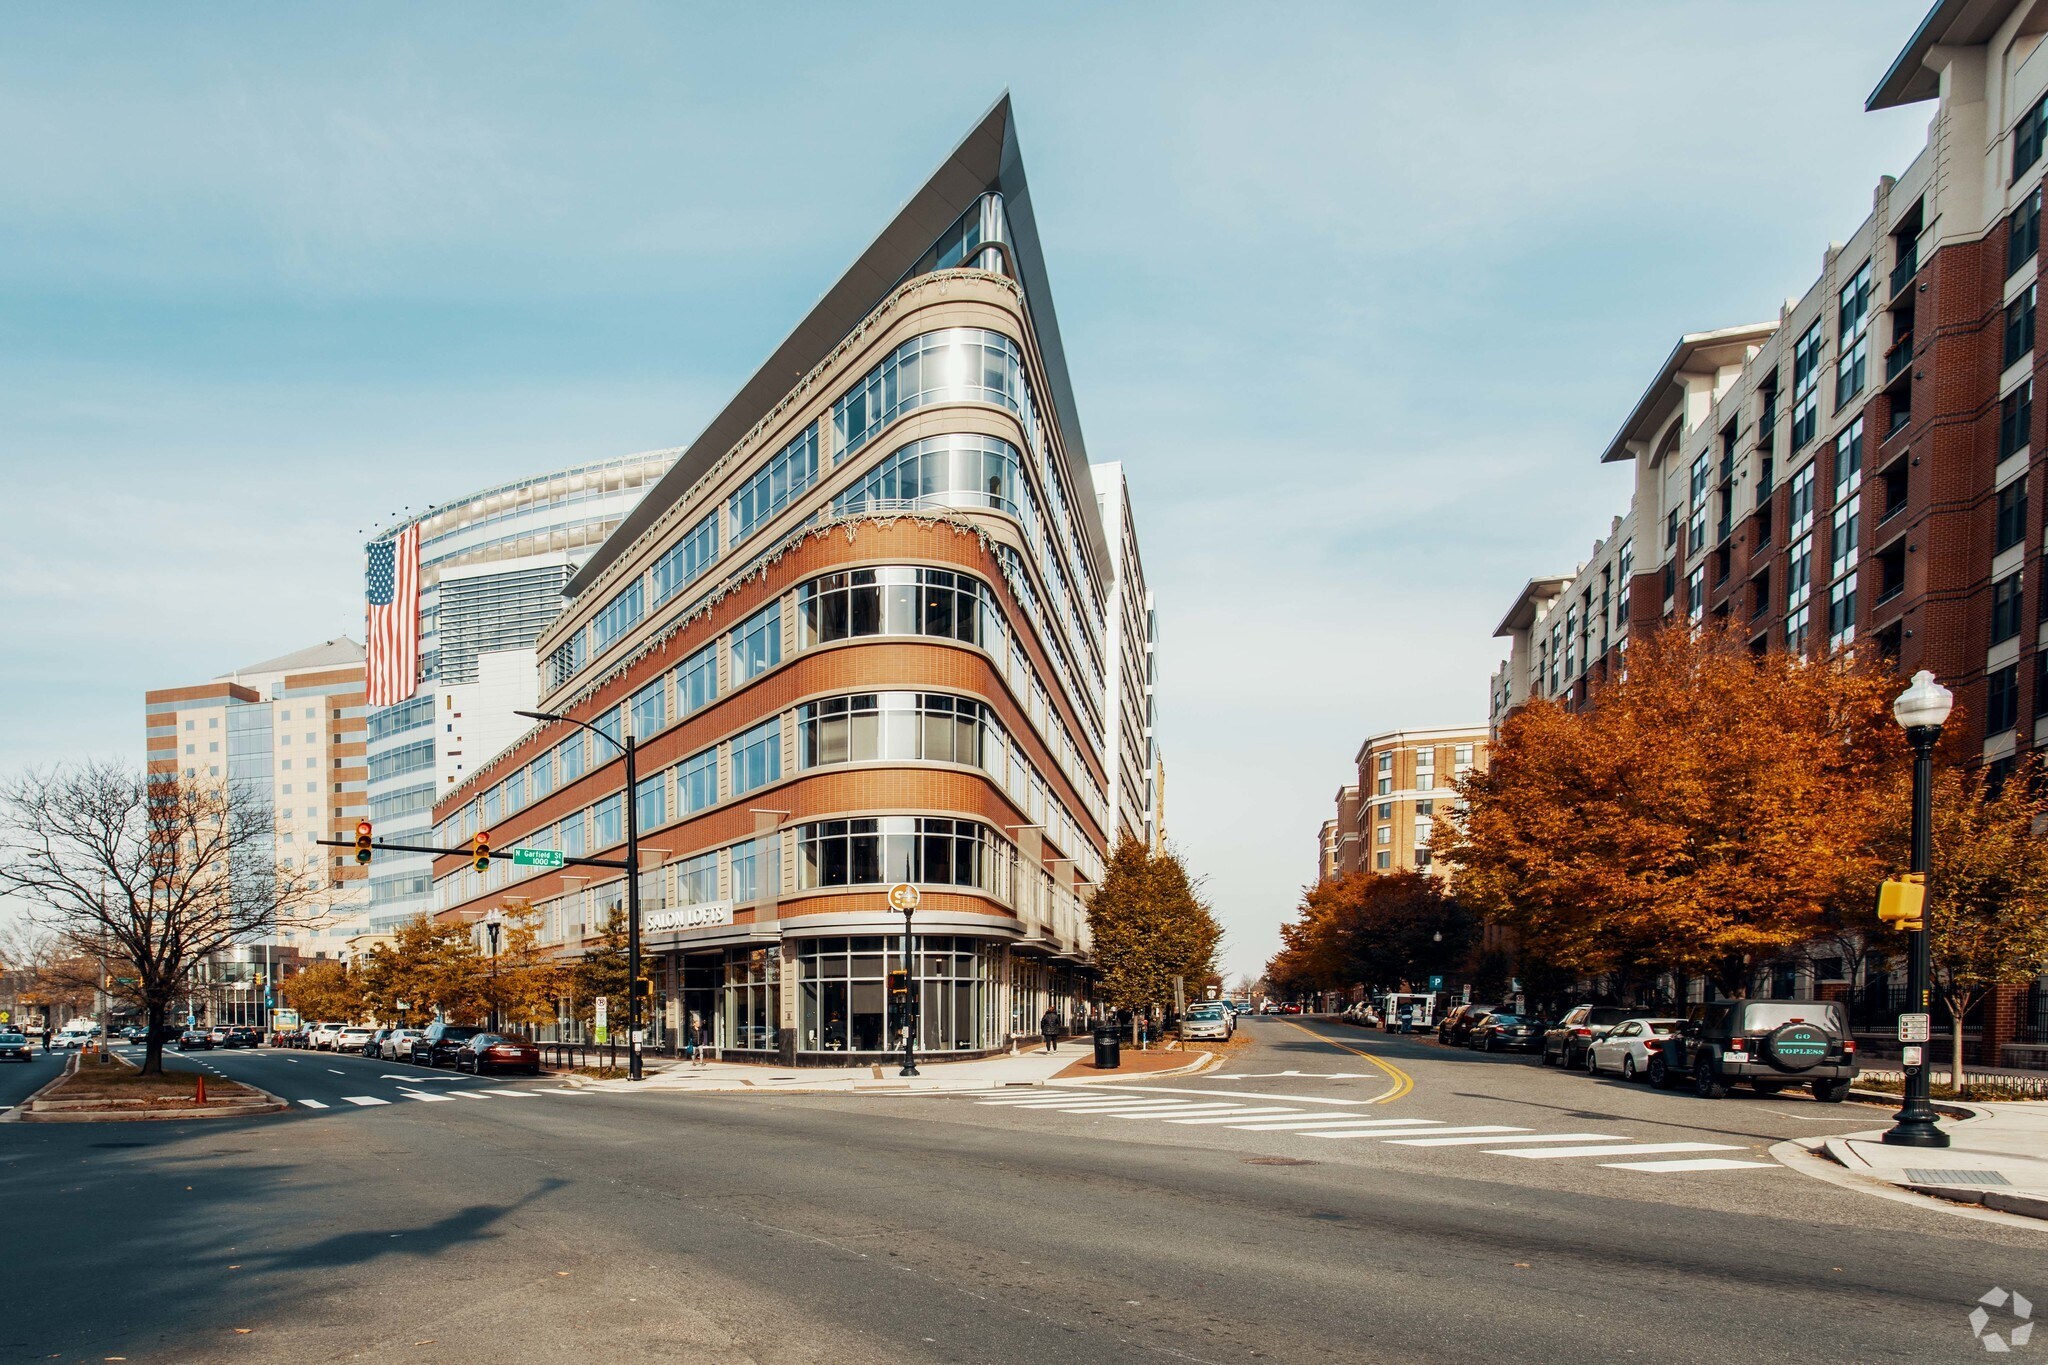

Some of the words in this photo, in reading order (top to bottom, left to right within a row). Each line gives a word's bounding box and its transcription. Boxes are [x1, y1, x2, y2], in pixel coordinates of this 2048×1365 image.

[524, 850, 550, 859] Garfield
[532, 858, 549, 866] 1000
[647, 911, 684, 931] SALON
[688, 906, 724, 926] LOFTS
[1434, 978, 1441, 986] P
